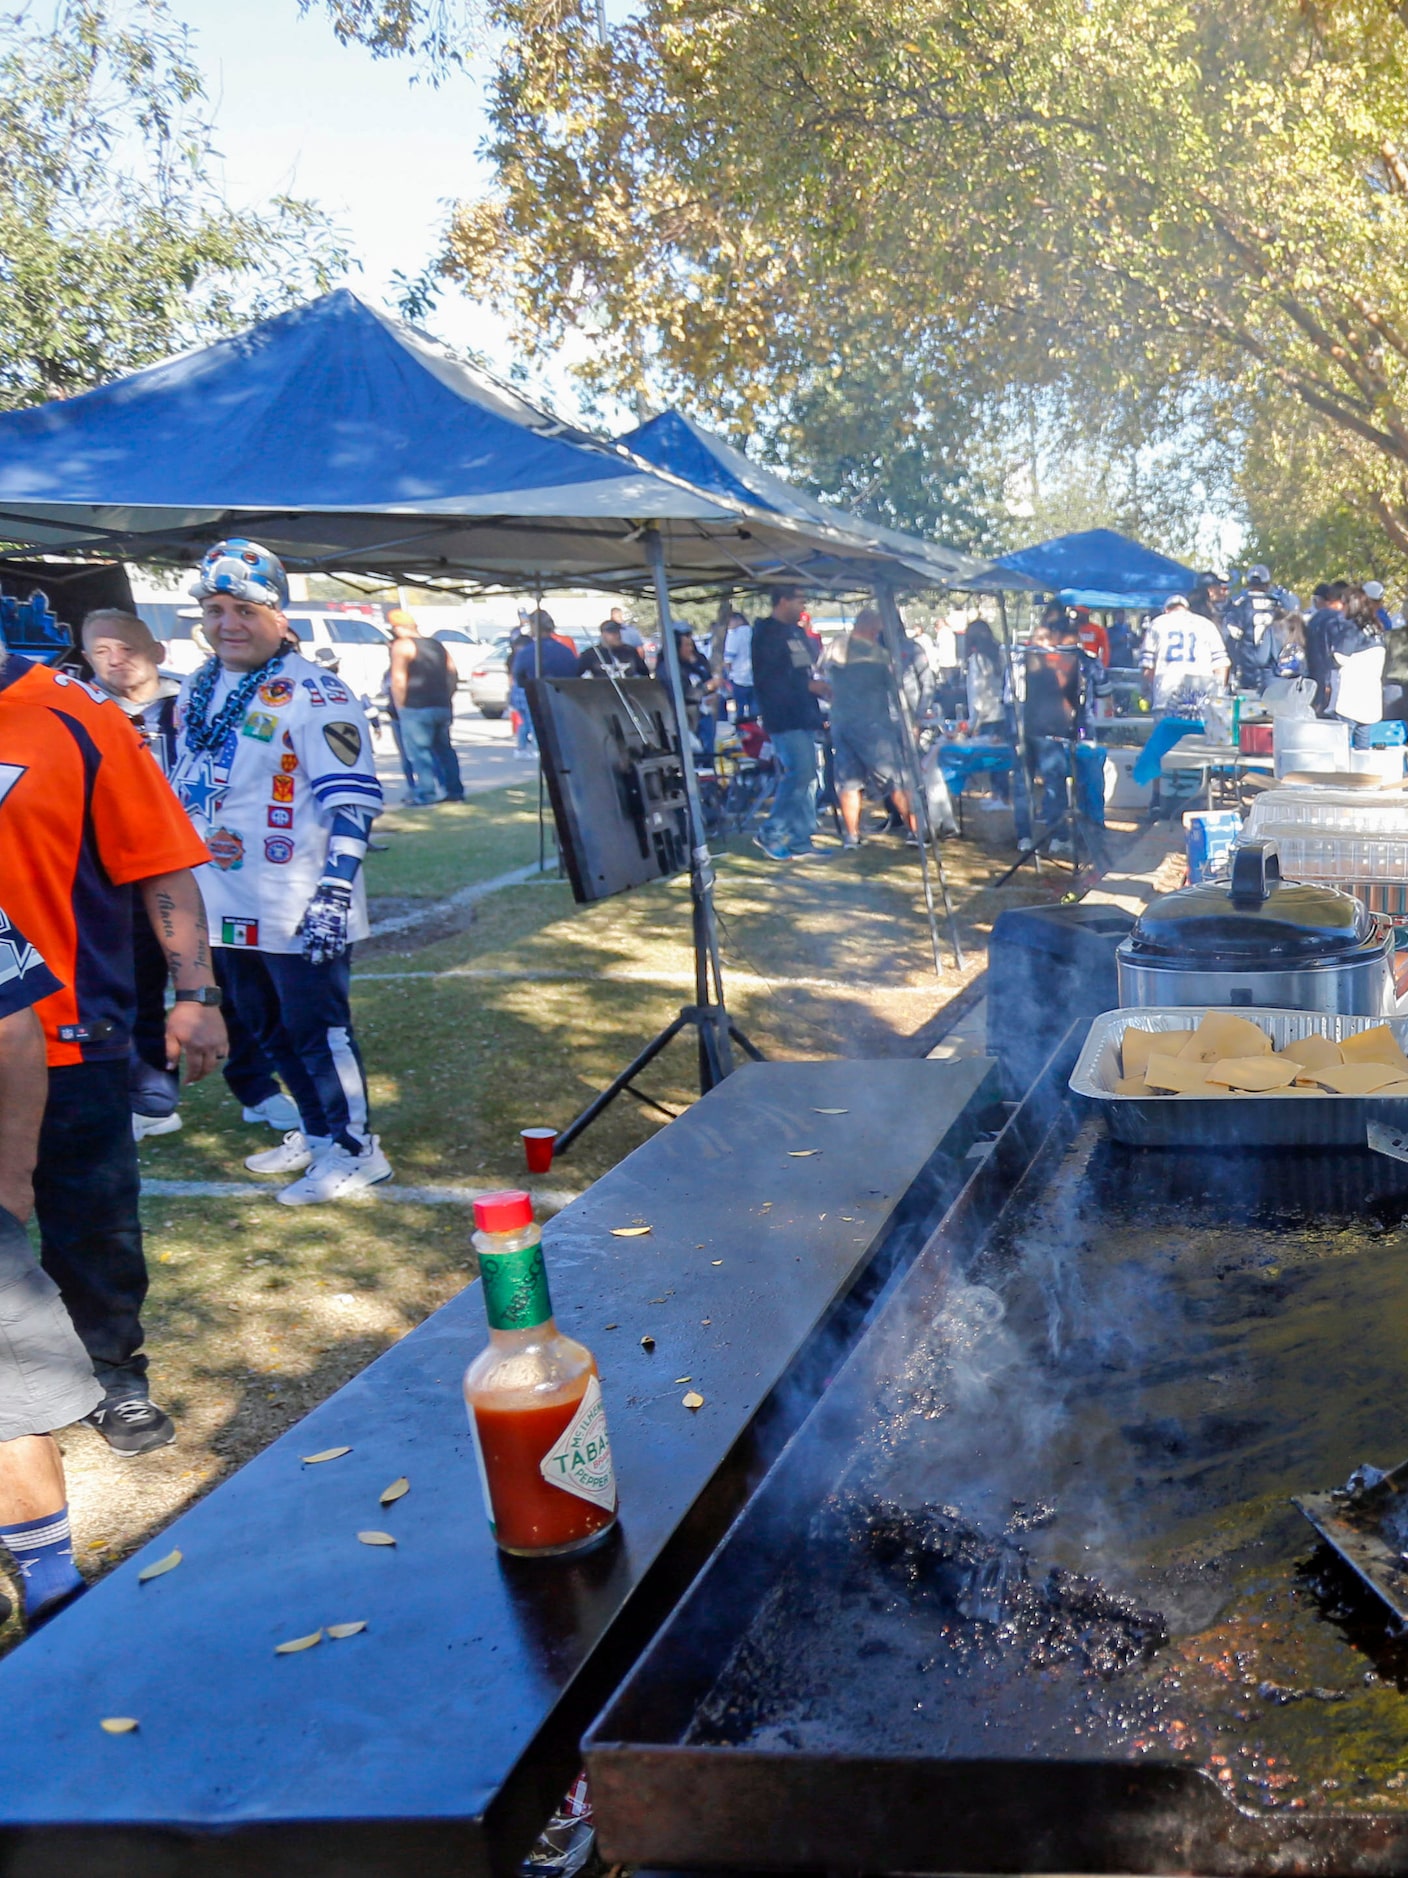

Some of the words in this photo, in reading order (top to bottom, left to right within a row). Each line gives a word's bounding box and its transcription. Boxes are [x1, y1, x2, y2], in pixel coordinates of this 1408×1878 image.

[1165, 630, 1197, 663] 21
[302, 675, 348, 707] 19
[575, 1468, 609, 1487] PEPPER
